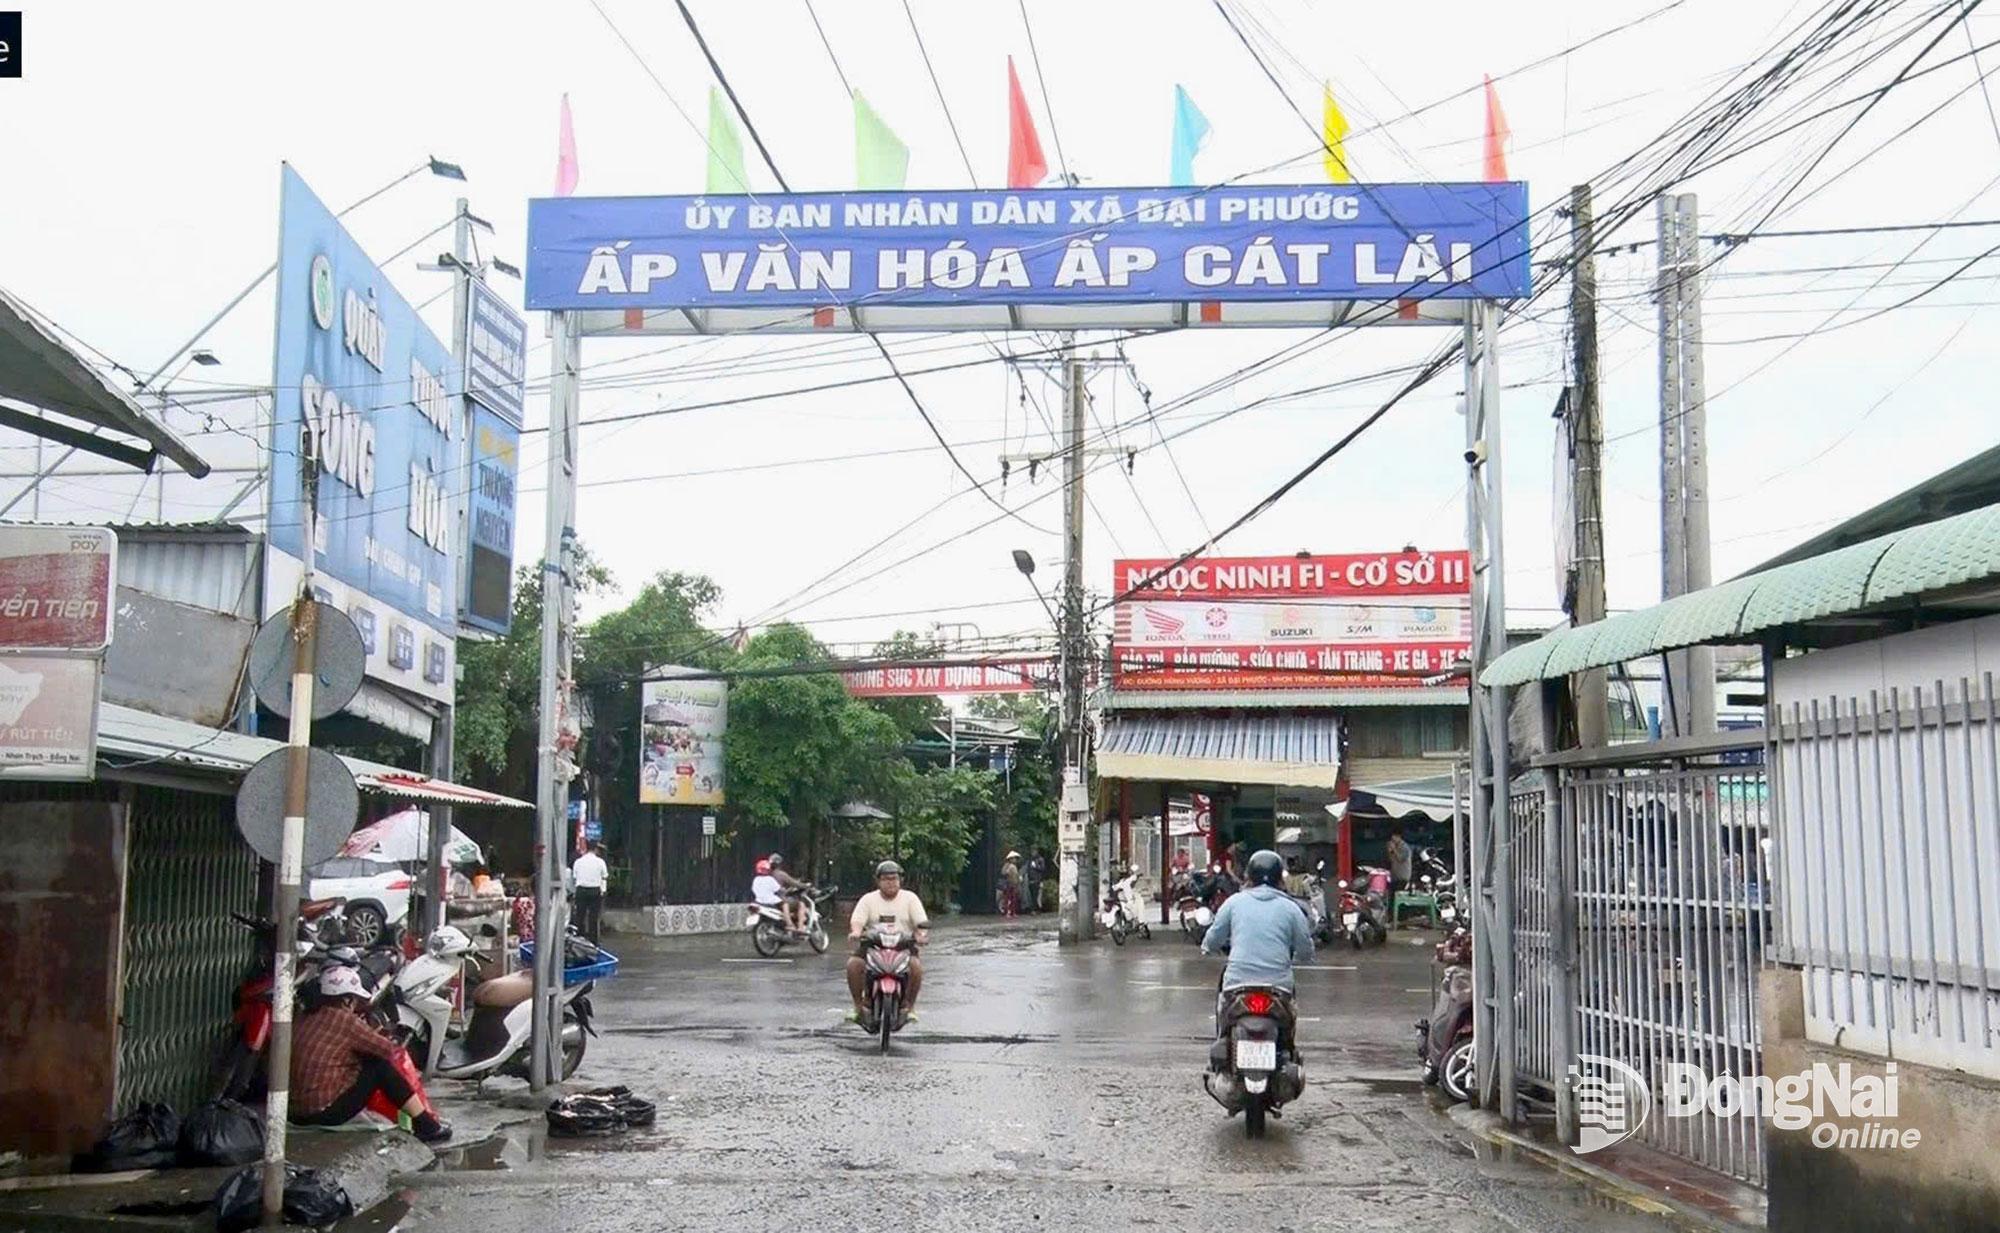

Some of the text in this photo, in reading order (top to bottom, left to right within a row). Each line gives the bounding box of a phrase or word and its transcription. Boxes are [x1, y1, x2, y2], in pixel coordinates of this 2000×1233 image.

[685, 191, 1359, 230] ỦY BAN NHÂN DÂN XÃ ĐẠI PHƯỚC
[577, 233, 1473, 295] ẤP VĂN HÓA ẤP CÁT LÁI
[300, 373, 450, 556] SONG HÒA
[71, 540, 99, 551] pay
[1127, 565, 1209, 597] NGỌC
[1215, 563, 1292, 590] NINH
[1299, 563, 1323, 588] FI
[1346, 557, 1388, 586] CƠ
[1394, 552, 1436, 585] SỞ
[1442, 559, 1464, 584] II
[1270, 627, 1313, 637] SUZUKI
[1403, 625, 1448, 634] PIAGGIO
[1344, 649, 1383, 671] TRANG
[1394, 649, 1409, 671] XE
[1412, 649, 1430, 671] GA
